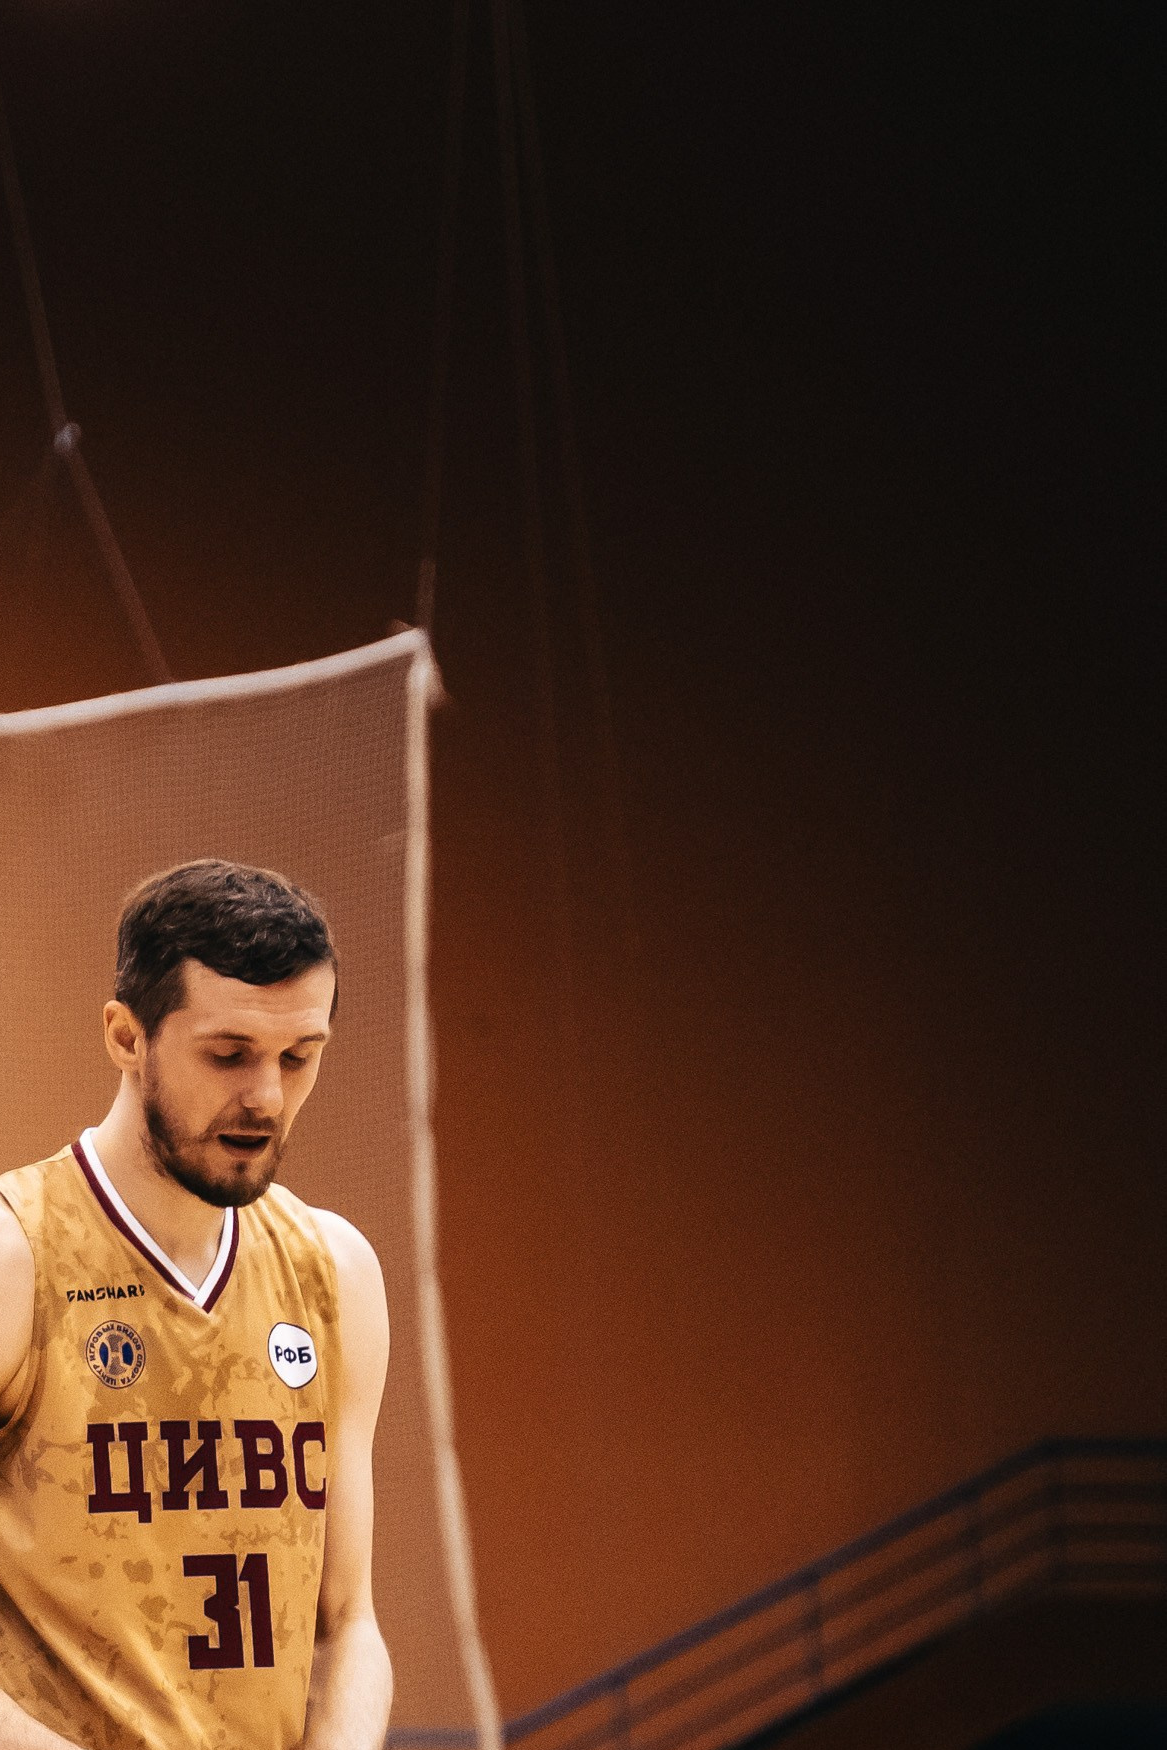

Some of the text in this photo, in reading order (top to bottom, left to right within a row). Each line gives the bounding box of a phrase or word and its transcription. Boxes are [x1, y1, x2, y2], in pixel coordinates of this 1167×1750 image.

[89, 1323, 143, 1386] ЦЕНТР ИГРОВЫХ ВИДОВ СПОРТА
[275, 1345, 312, 1364] РФБ
[86, 1420, 326, 1524] ЦИВС
[182, 1552, 275, 1670] 31
